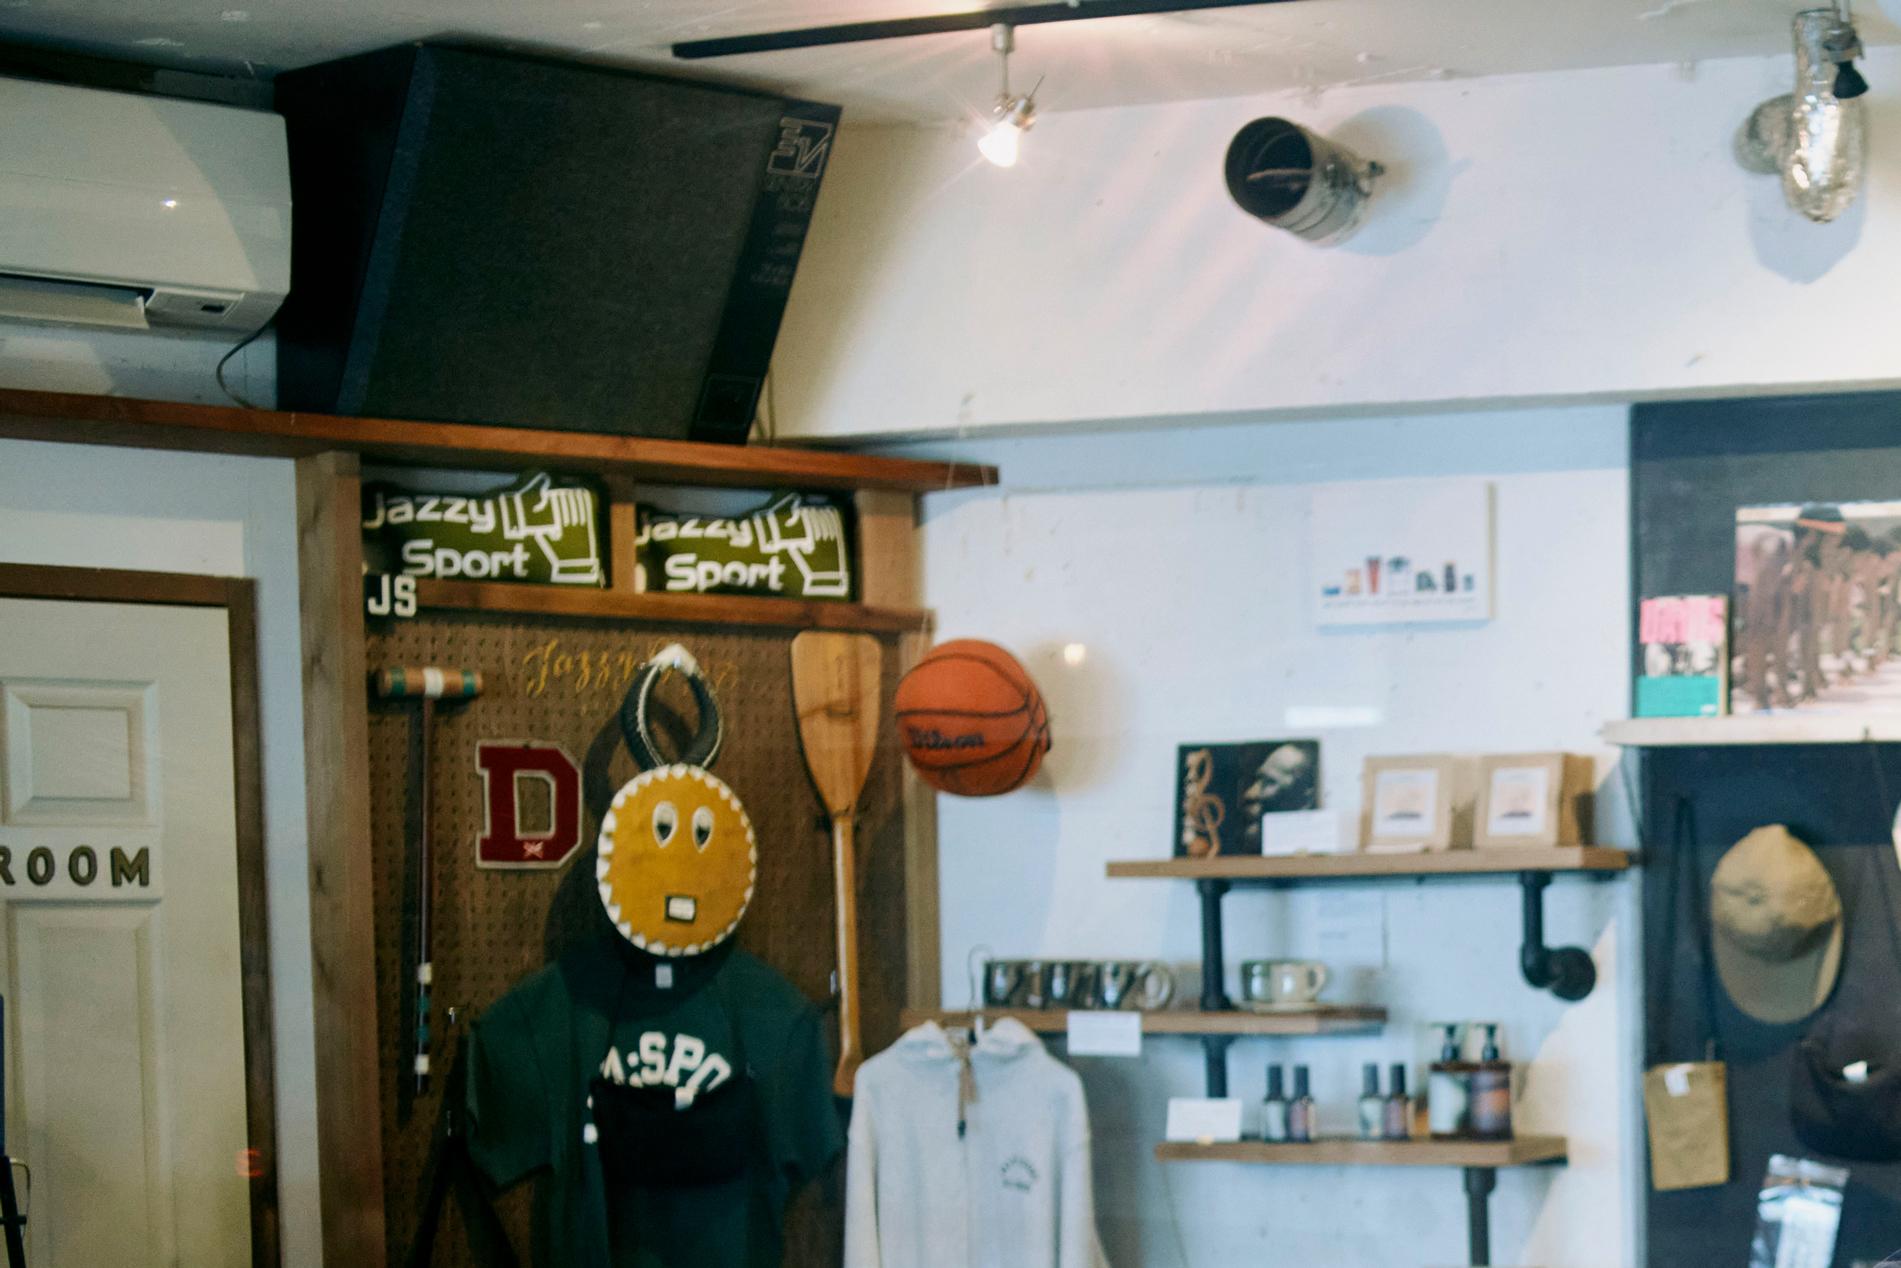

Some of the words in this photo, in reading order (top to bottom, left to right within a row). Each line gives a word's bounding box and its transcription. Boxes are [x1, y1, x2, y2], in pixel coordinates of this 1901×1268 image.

[401, 539, 531, 579] Sport
[665, 552, 786, 592] Sport
[367, 574, 417, 617] JS
[907, 726, 985, 751] Wilson
[475, 739, 584, 871] D
